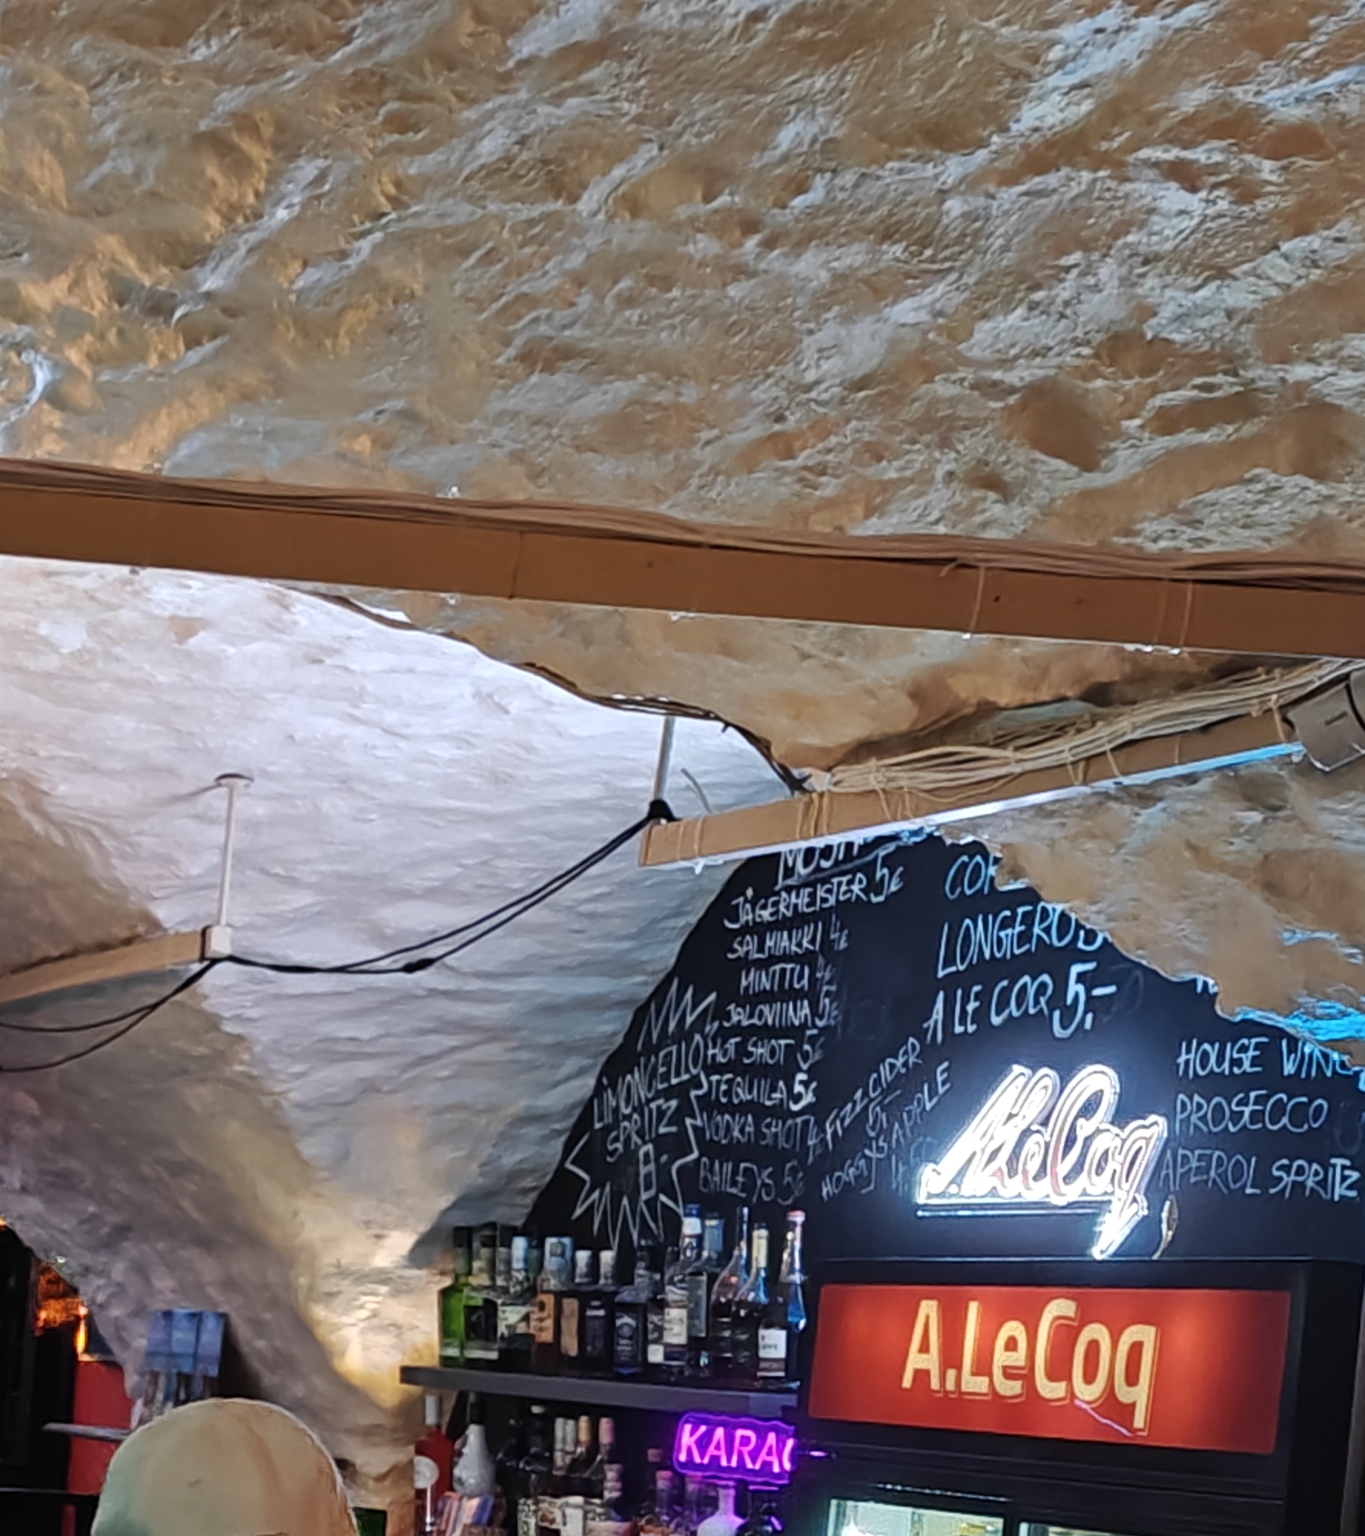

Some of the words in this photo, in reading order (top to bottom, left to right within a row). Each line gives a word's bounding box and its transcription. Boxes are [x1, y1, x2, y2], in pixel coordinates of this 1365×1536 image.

[726, 920, 822, 960] SALMIAKKI
[740, 963, 810, 996] MINTTU
[989, 973, 1055, 1027] COQ
[722, 999, 813, 1029] JALOVIINA
[707, 1036, 742, 1065] HOT
[742, 1036, 796, 1066] SHOT
[1176, 1036, 1270, 1080] HOUSE
[709, 1073, 788, 1109] TEQUILA
[606, 1098, 680, 1163] SPRITZ
[702, 1110, 755, 1146] VODKA
[760, 1113, 814, 1152] SHOT
[1175, 1090, 1329, 1137] PROSECCO
[699, 1156, 775, 1204] BAILEYS
[1159, 1147, 1262, 1196] APEROL
[1269, 1157, 1362, 1202] SPRITZ
[902, 1297, 1159, 1435] A.LeCoq
